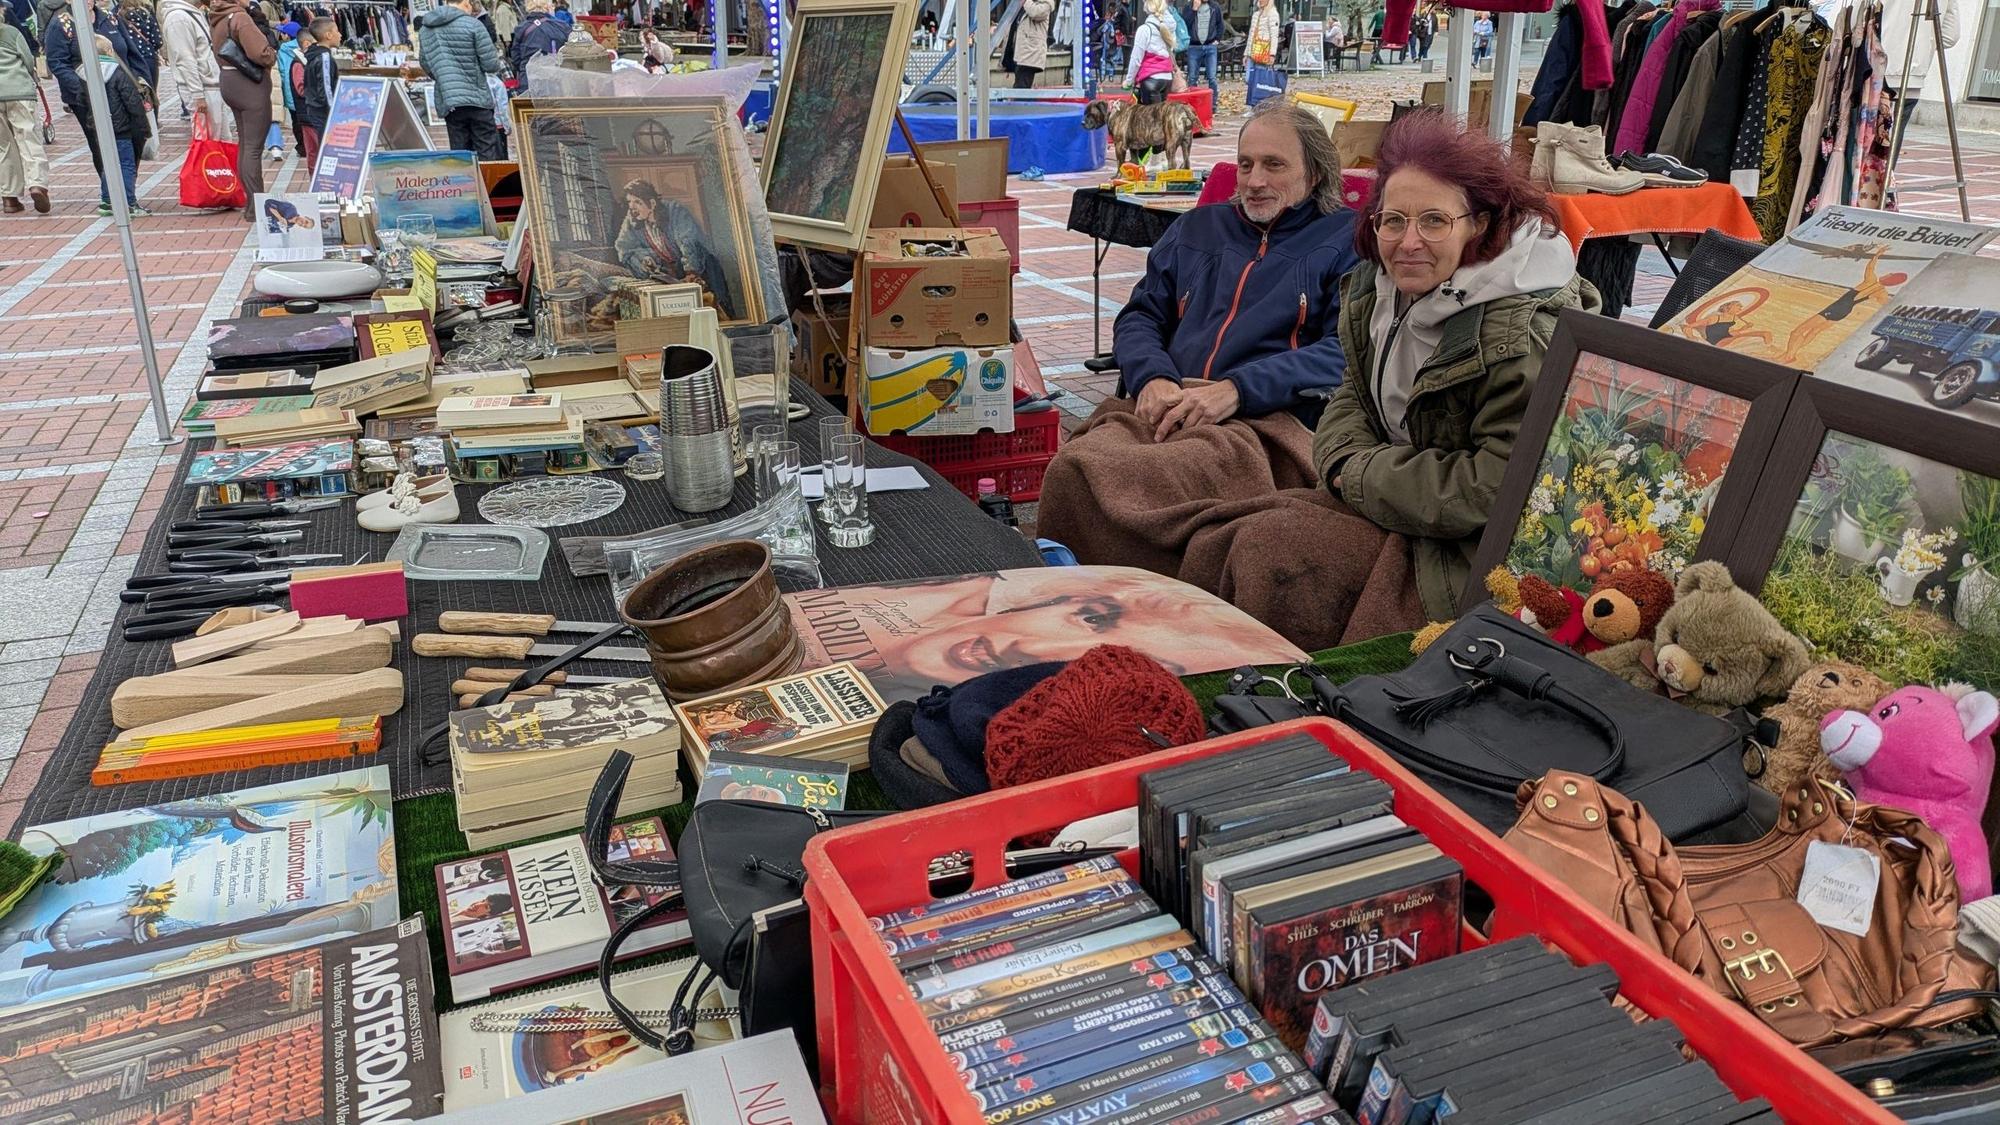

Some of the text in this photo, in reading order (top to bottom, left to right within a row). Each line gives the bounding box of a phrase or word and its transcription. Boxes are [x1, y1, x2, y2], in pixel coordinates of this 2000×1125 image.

[395, 176, 451, 189] Malen &
[397, 187, 462, 201] Zeichnen
[1815, 212, 1983, 248] Fliegt in die Bäder!
[980, 376, 1006, 386] Chiquita
[823, 669, 877, 719] LASSITER
[286, 820, 312, 902] Illusionsmalerei
[515, 858, 551, 925] WISSEN
[537, 849, 585, 921] WEIN
[1012, 898, 1076, 918] DOPPELMORD
[1393, 893, 1435, 914] FARROW
[1330, 908, 1384, 931] SCHREIBER
[1287, 926, 1319, 944] STILES
[1344, 928, 1378, 951] DAS
[1043, 942, 1085, 959] Kleiner
[1298, 930, 1422, 993] OMEN
[333, 963, 346, 979] Von
[333, 980, 346, 999] Hans
[1031, 986, 1054, 1001] Movie
[1056, 978, 1084, 994] Edition
[331, 1000, 346, 1028] Koning
[1046, 1002, 1069, 1017] Movie
[1071, 994, 1099, 1010] Edition
[1117, 1001, 1157, 1019] FEMALE
[406, 978, 425, 1064] DIE GROSSEN STÄDTE
[1073, 1013, 1114, 1032] AGENTS
[1108, 1008, 1173, 1033] BACKWOODS
[333, 1030, 347, 1057] Photos
[950, 1028, 1008, 1050] THE FIRST
[1138, 1031, 1187, 1051] TAXI TAXI
[334, 1058, 346, 1075] von
[1092, 1073, 1117, 1088] Movie
[1119, 1064, 1149, 1080] Edition
[335, 1075, 349, 1104] Patrick
[1015, 1094, 1057, 1114] ZONE
[1149, 1101, 1179, 1118] Edition
